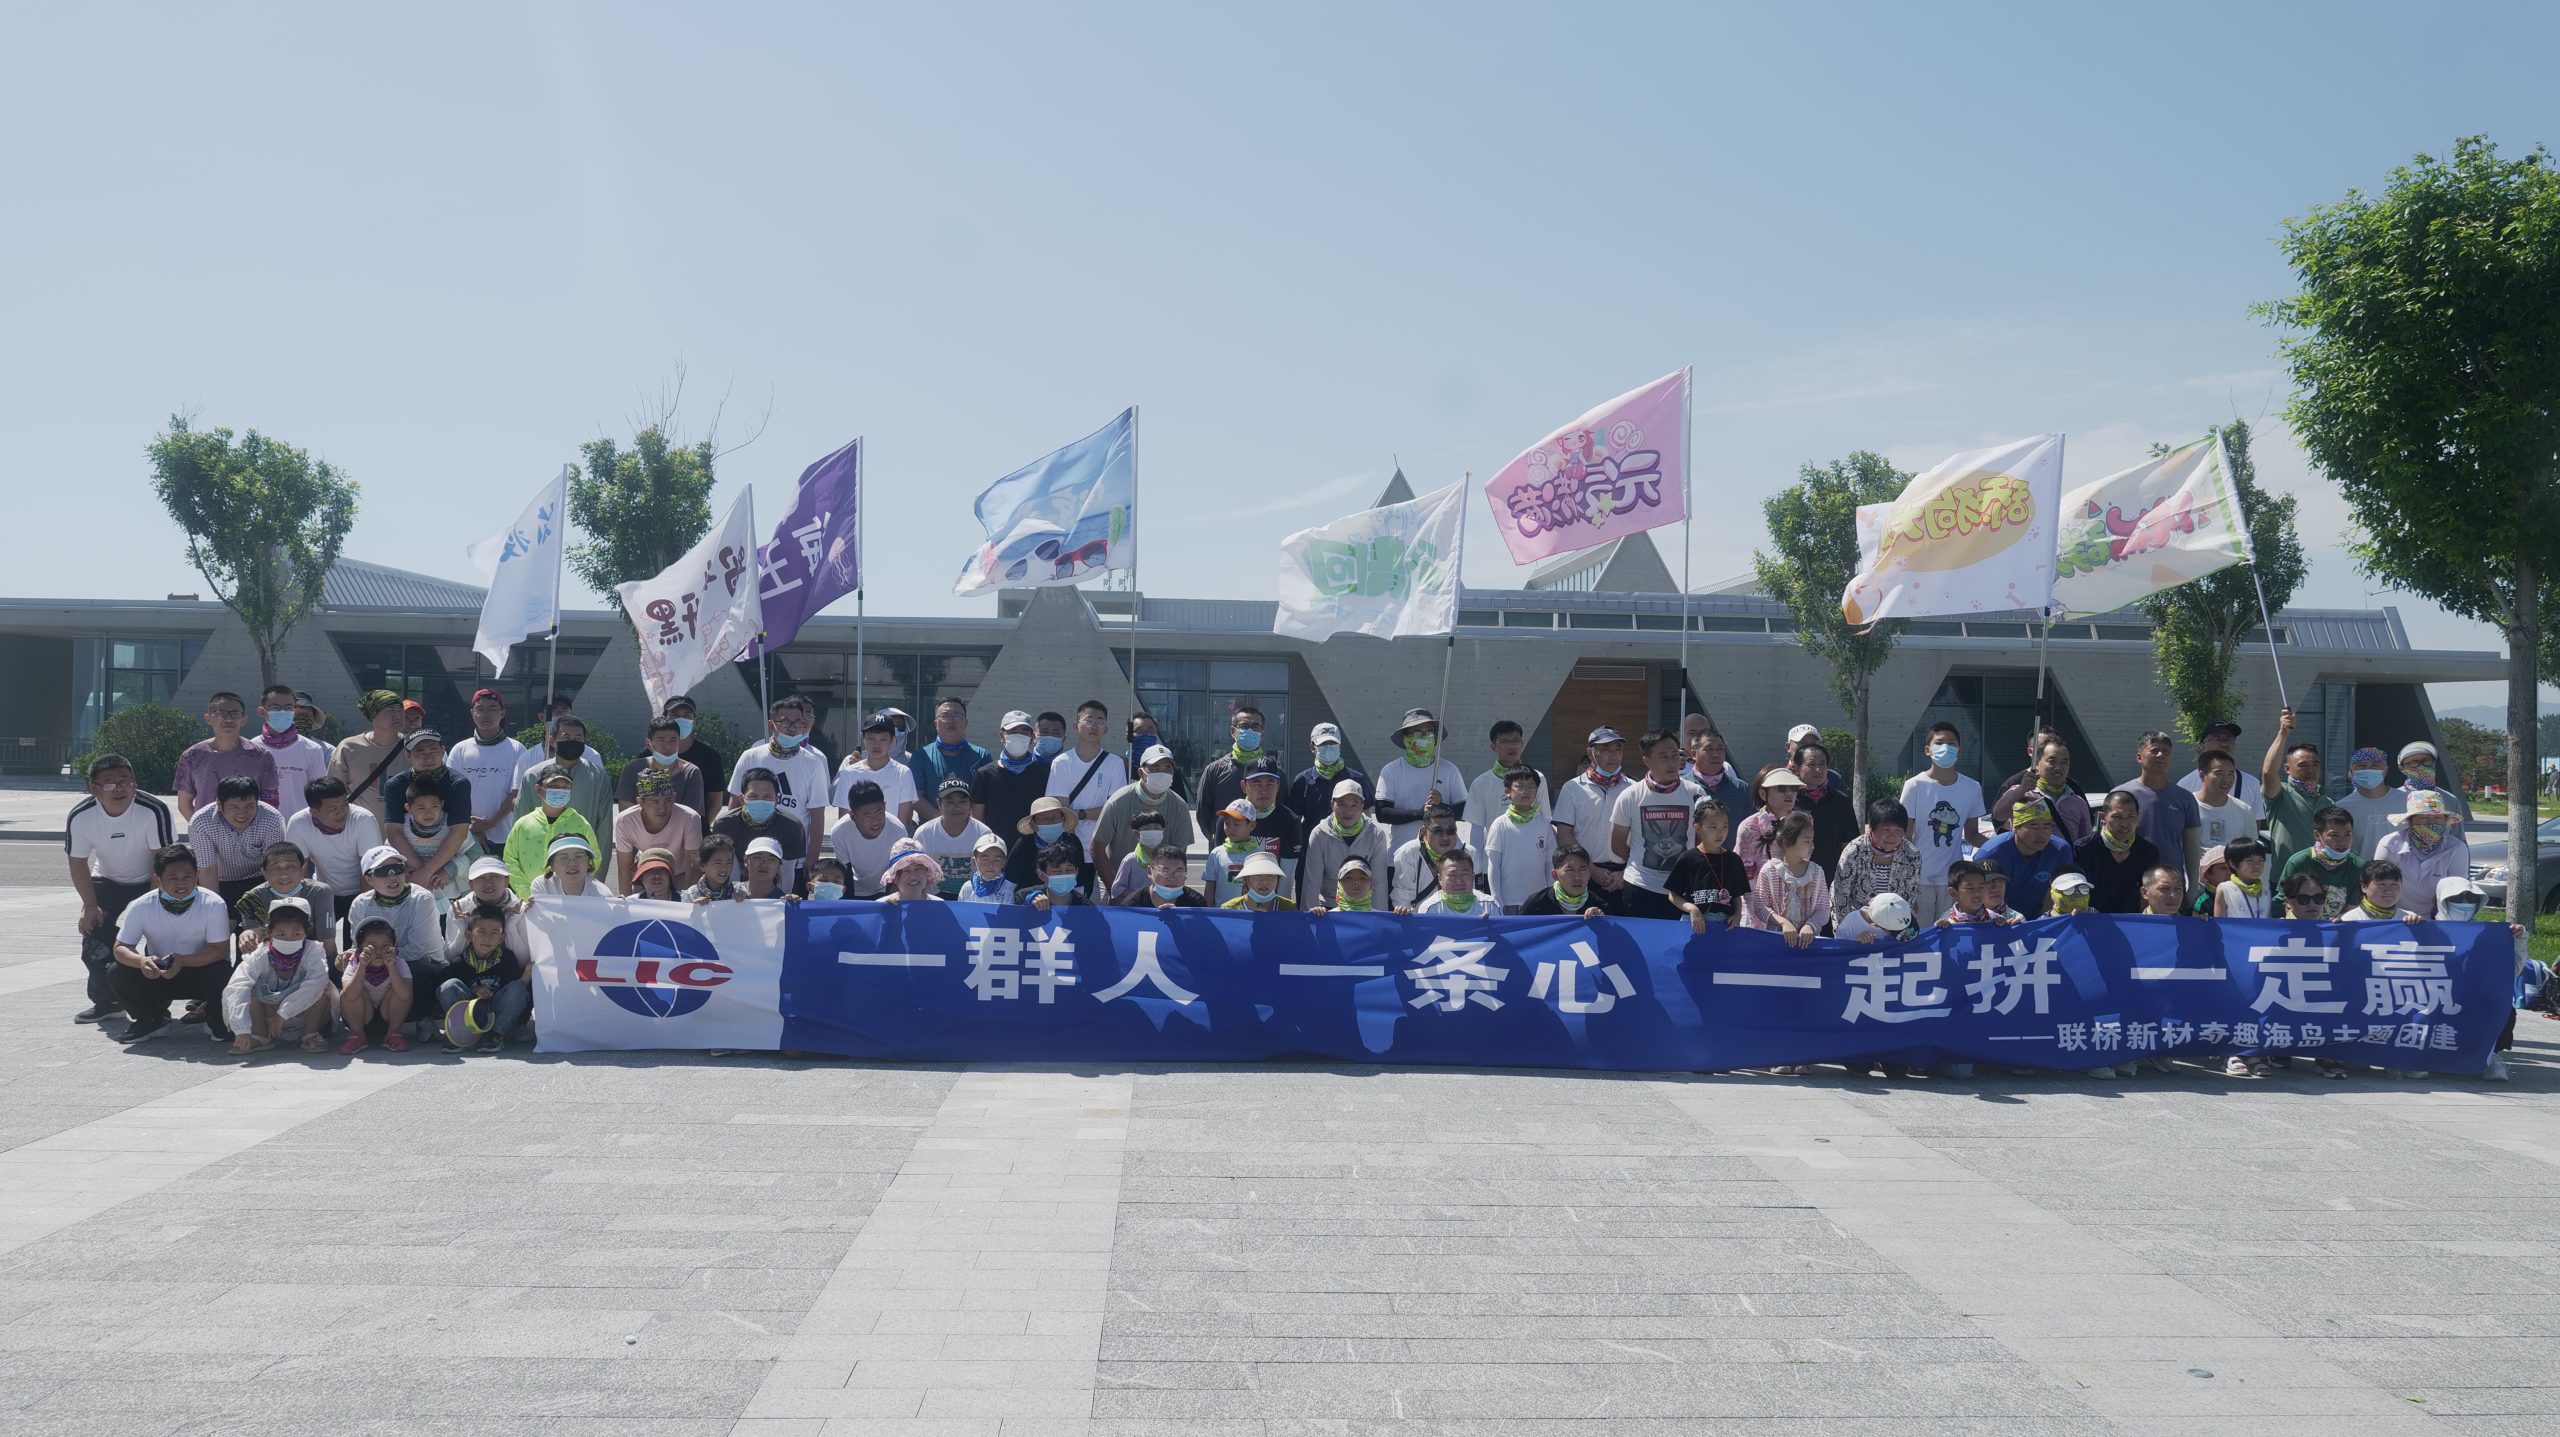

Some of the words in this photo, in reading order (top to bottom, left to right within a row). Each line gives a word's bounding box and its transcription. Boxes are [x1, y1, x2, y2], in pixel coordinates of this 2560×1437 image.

[1645, 811, 1666, 820] LOONEY
[1667, 811, 1685, 820] TUNES
[576, 959, 734, 987] LIC
[838, 927, 1200, 1006] 一群人
[1279, 936, 1637, 1015] 一条心
[1713, 937, 2062, 1024] 一起拼
[2129, 938, 2463, 1017] 一定赢
